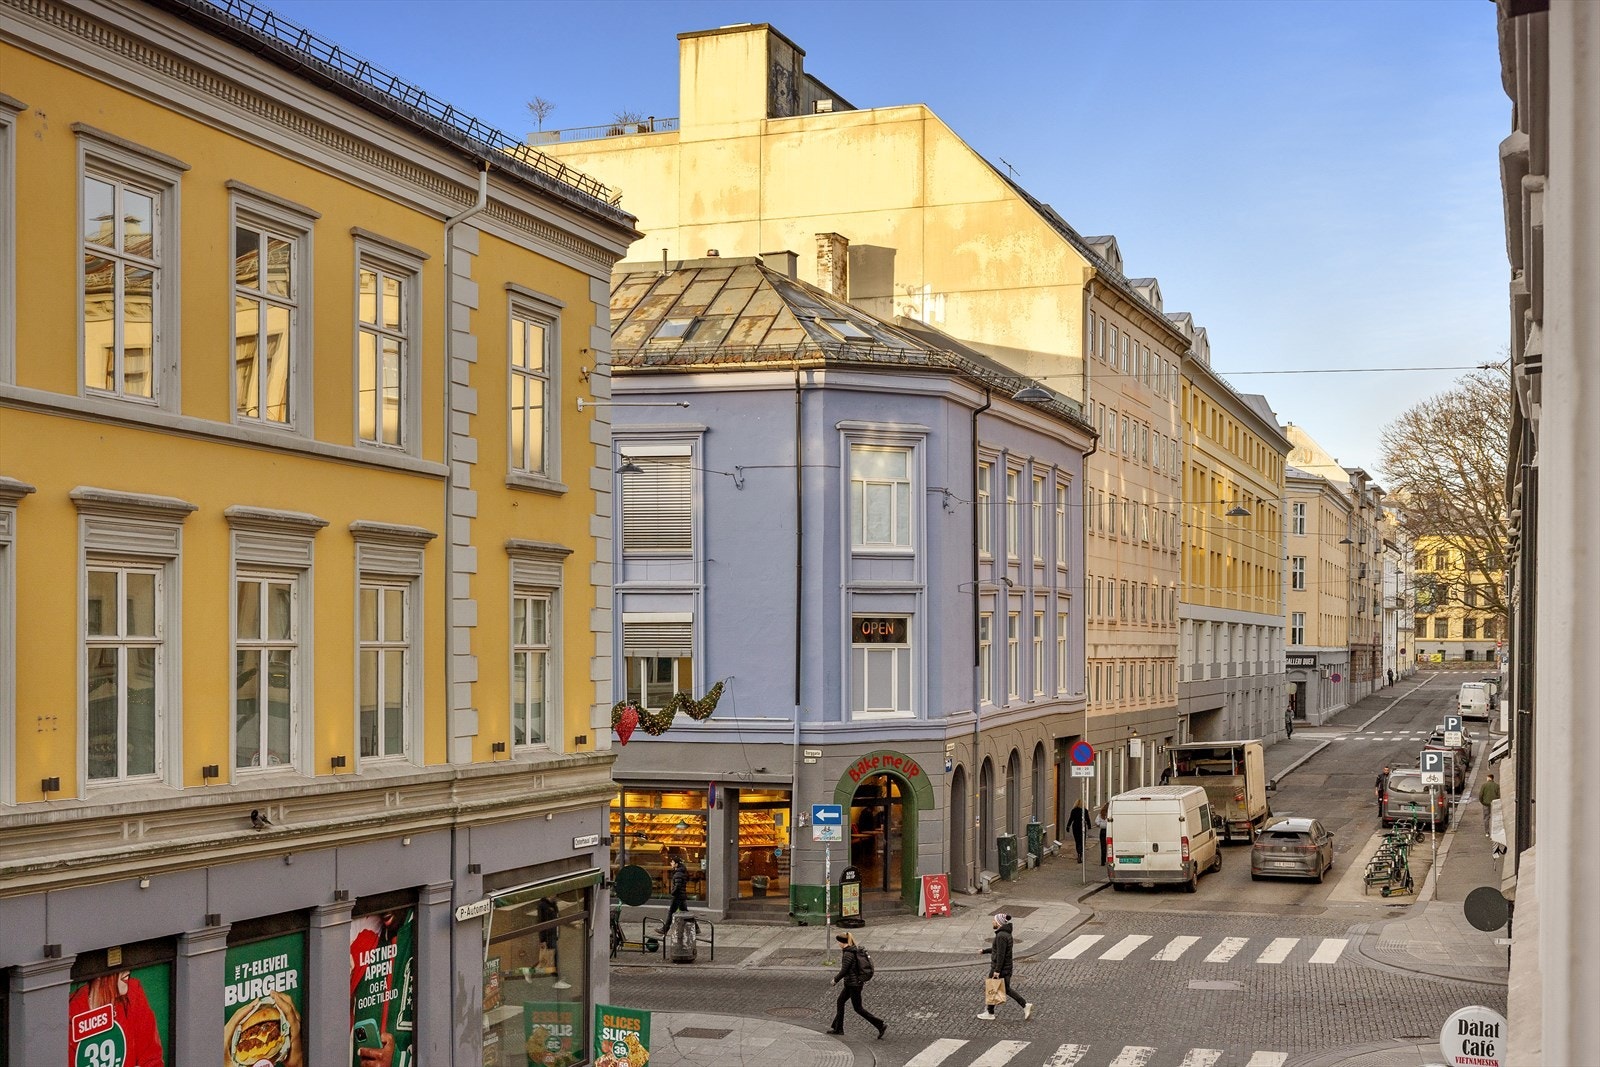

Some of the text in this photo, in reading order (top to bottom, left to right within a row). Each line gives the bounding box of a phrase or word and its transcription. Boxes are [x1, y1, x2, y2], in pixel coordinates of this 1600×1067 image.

[862, 621, 895, 635] OPEN
[1448, 717, 1458, 730] P
[848, 756, 880, 783] Bake
[882, 755, 903, 769] me
[1426, 754, 1438, 770] P
[460, 902, 490, 919] P-Automat
[359, 943, 398, 967] LAST NED
[364, 960, 393, 981] APPEN
[225, 969, 298, 1007] BURGER
[369, 976, 388, 994] OG FÅ
[358, 989, 398, 1010] GODE TILBUD
[78, 1012, 108, 1034] SLICES
[603, 1014, 641, 1031] SLICES
[1462, 1039, 1495, 1057] Café
[1455, 1056, 1499, 1067] VIETNAMESISK
